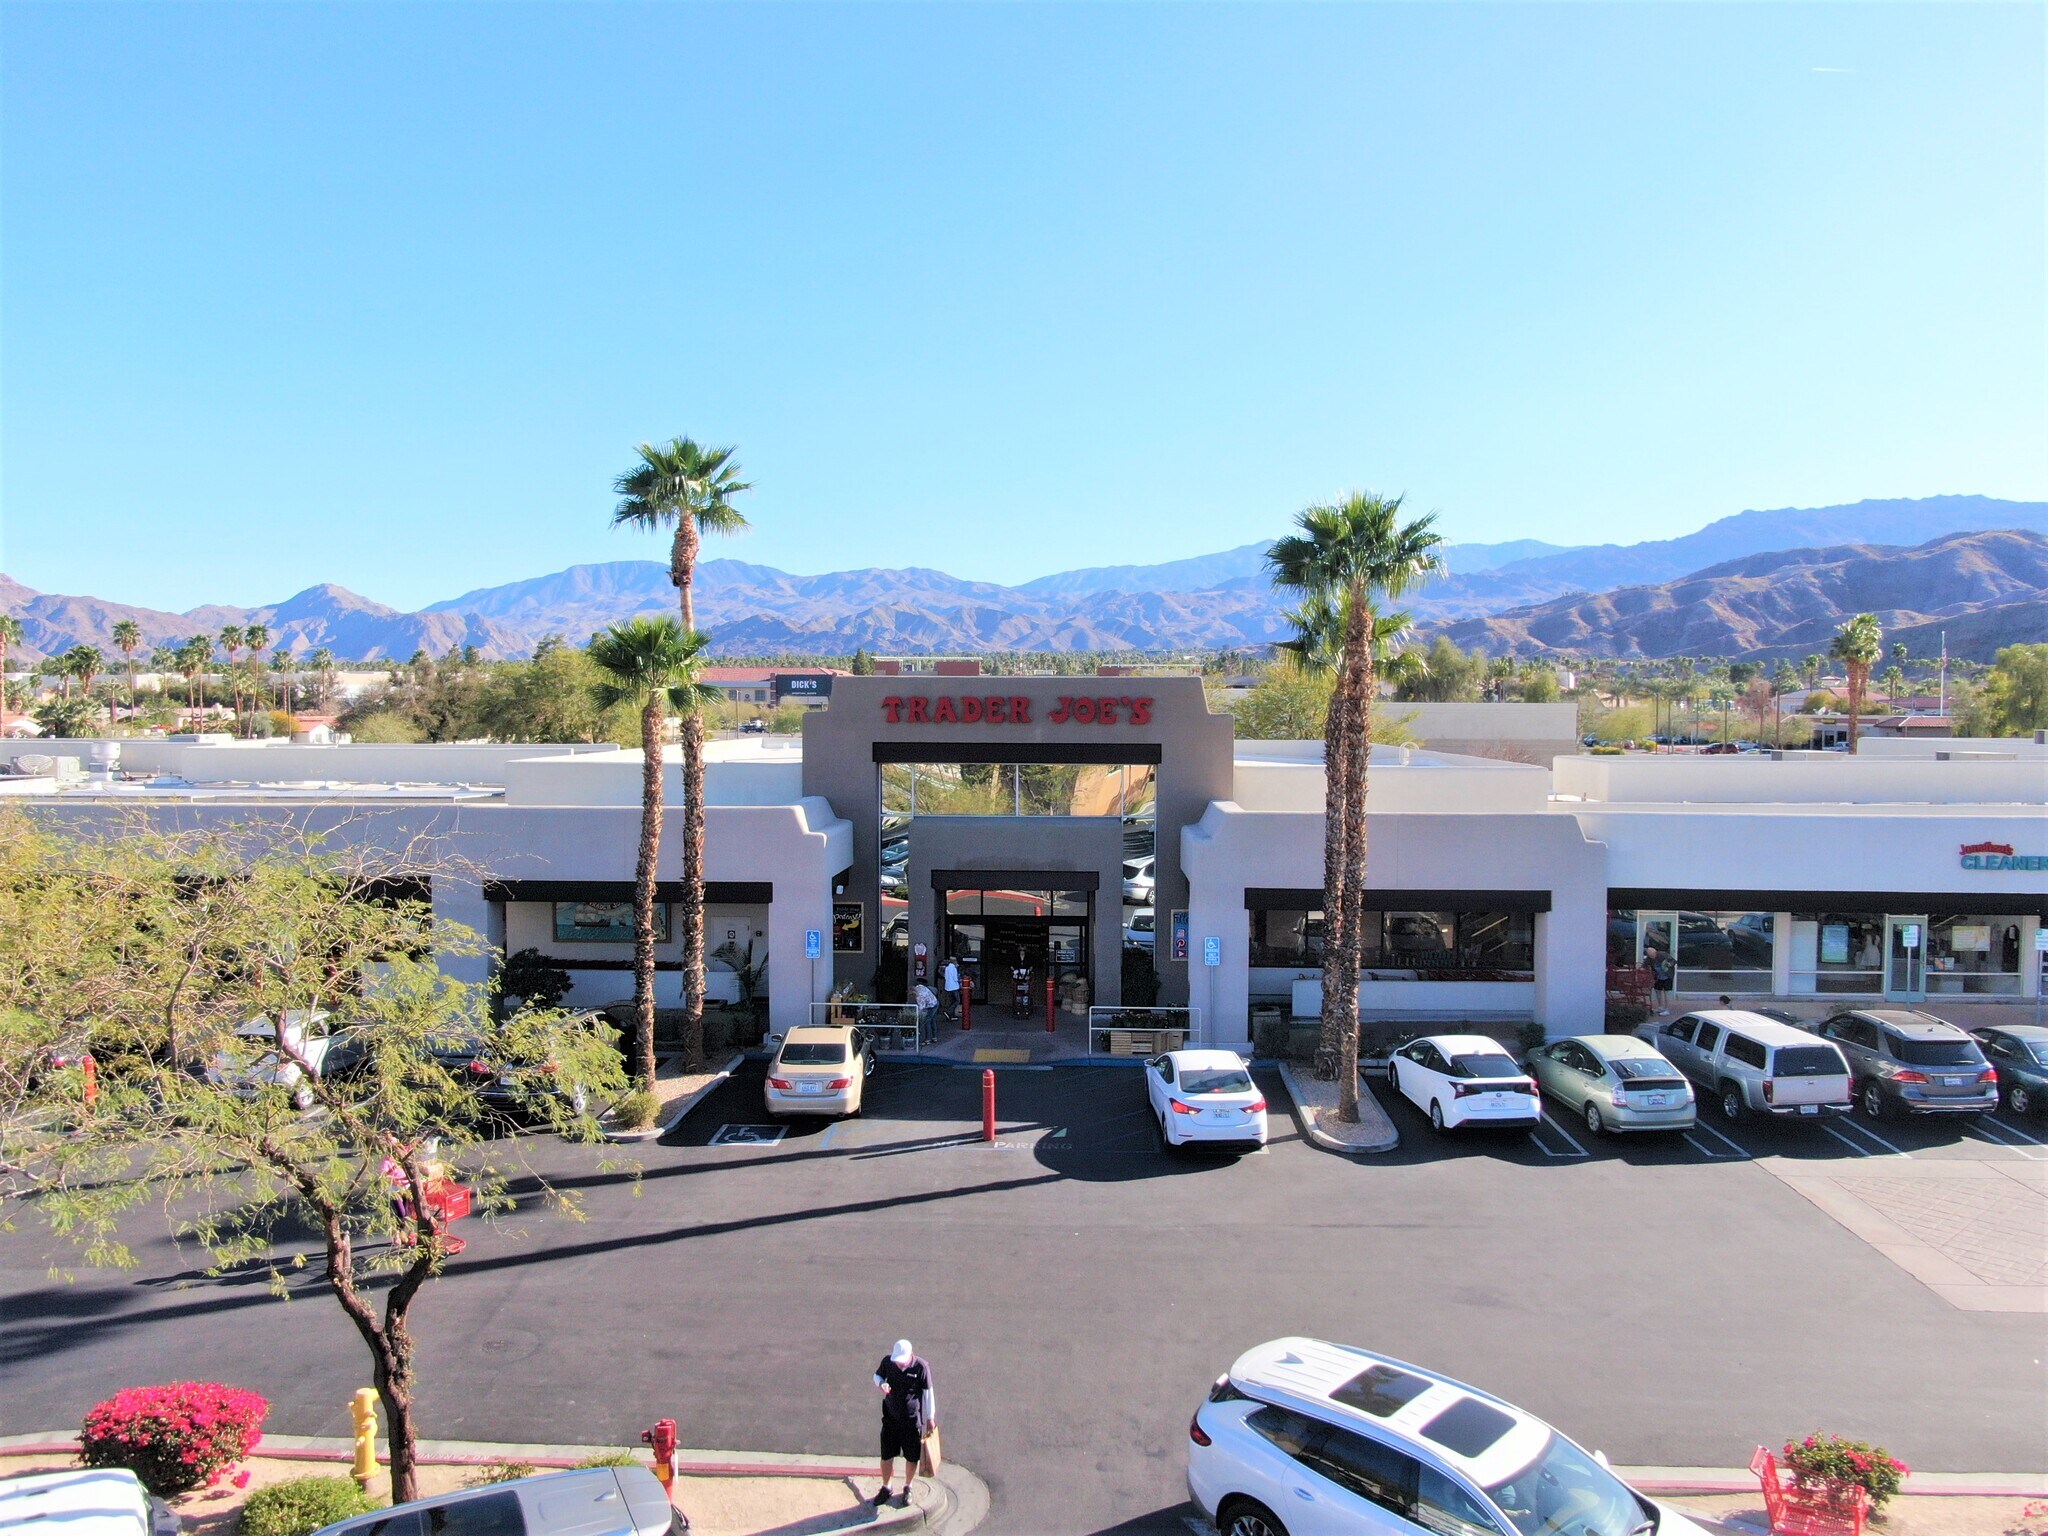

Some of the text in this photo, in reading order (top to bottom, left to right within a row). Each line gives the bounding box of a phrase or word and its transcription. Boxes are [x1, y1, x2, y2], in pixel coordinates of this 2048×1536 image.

[791, 680, 817, 689] DICK'S
[881, 696, 1153, 725] TRADER JOE'S
[993, 1140, 1073, 1149] PARKING
